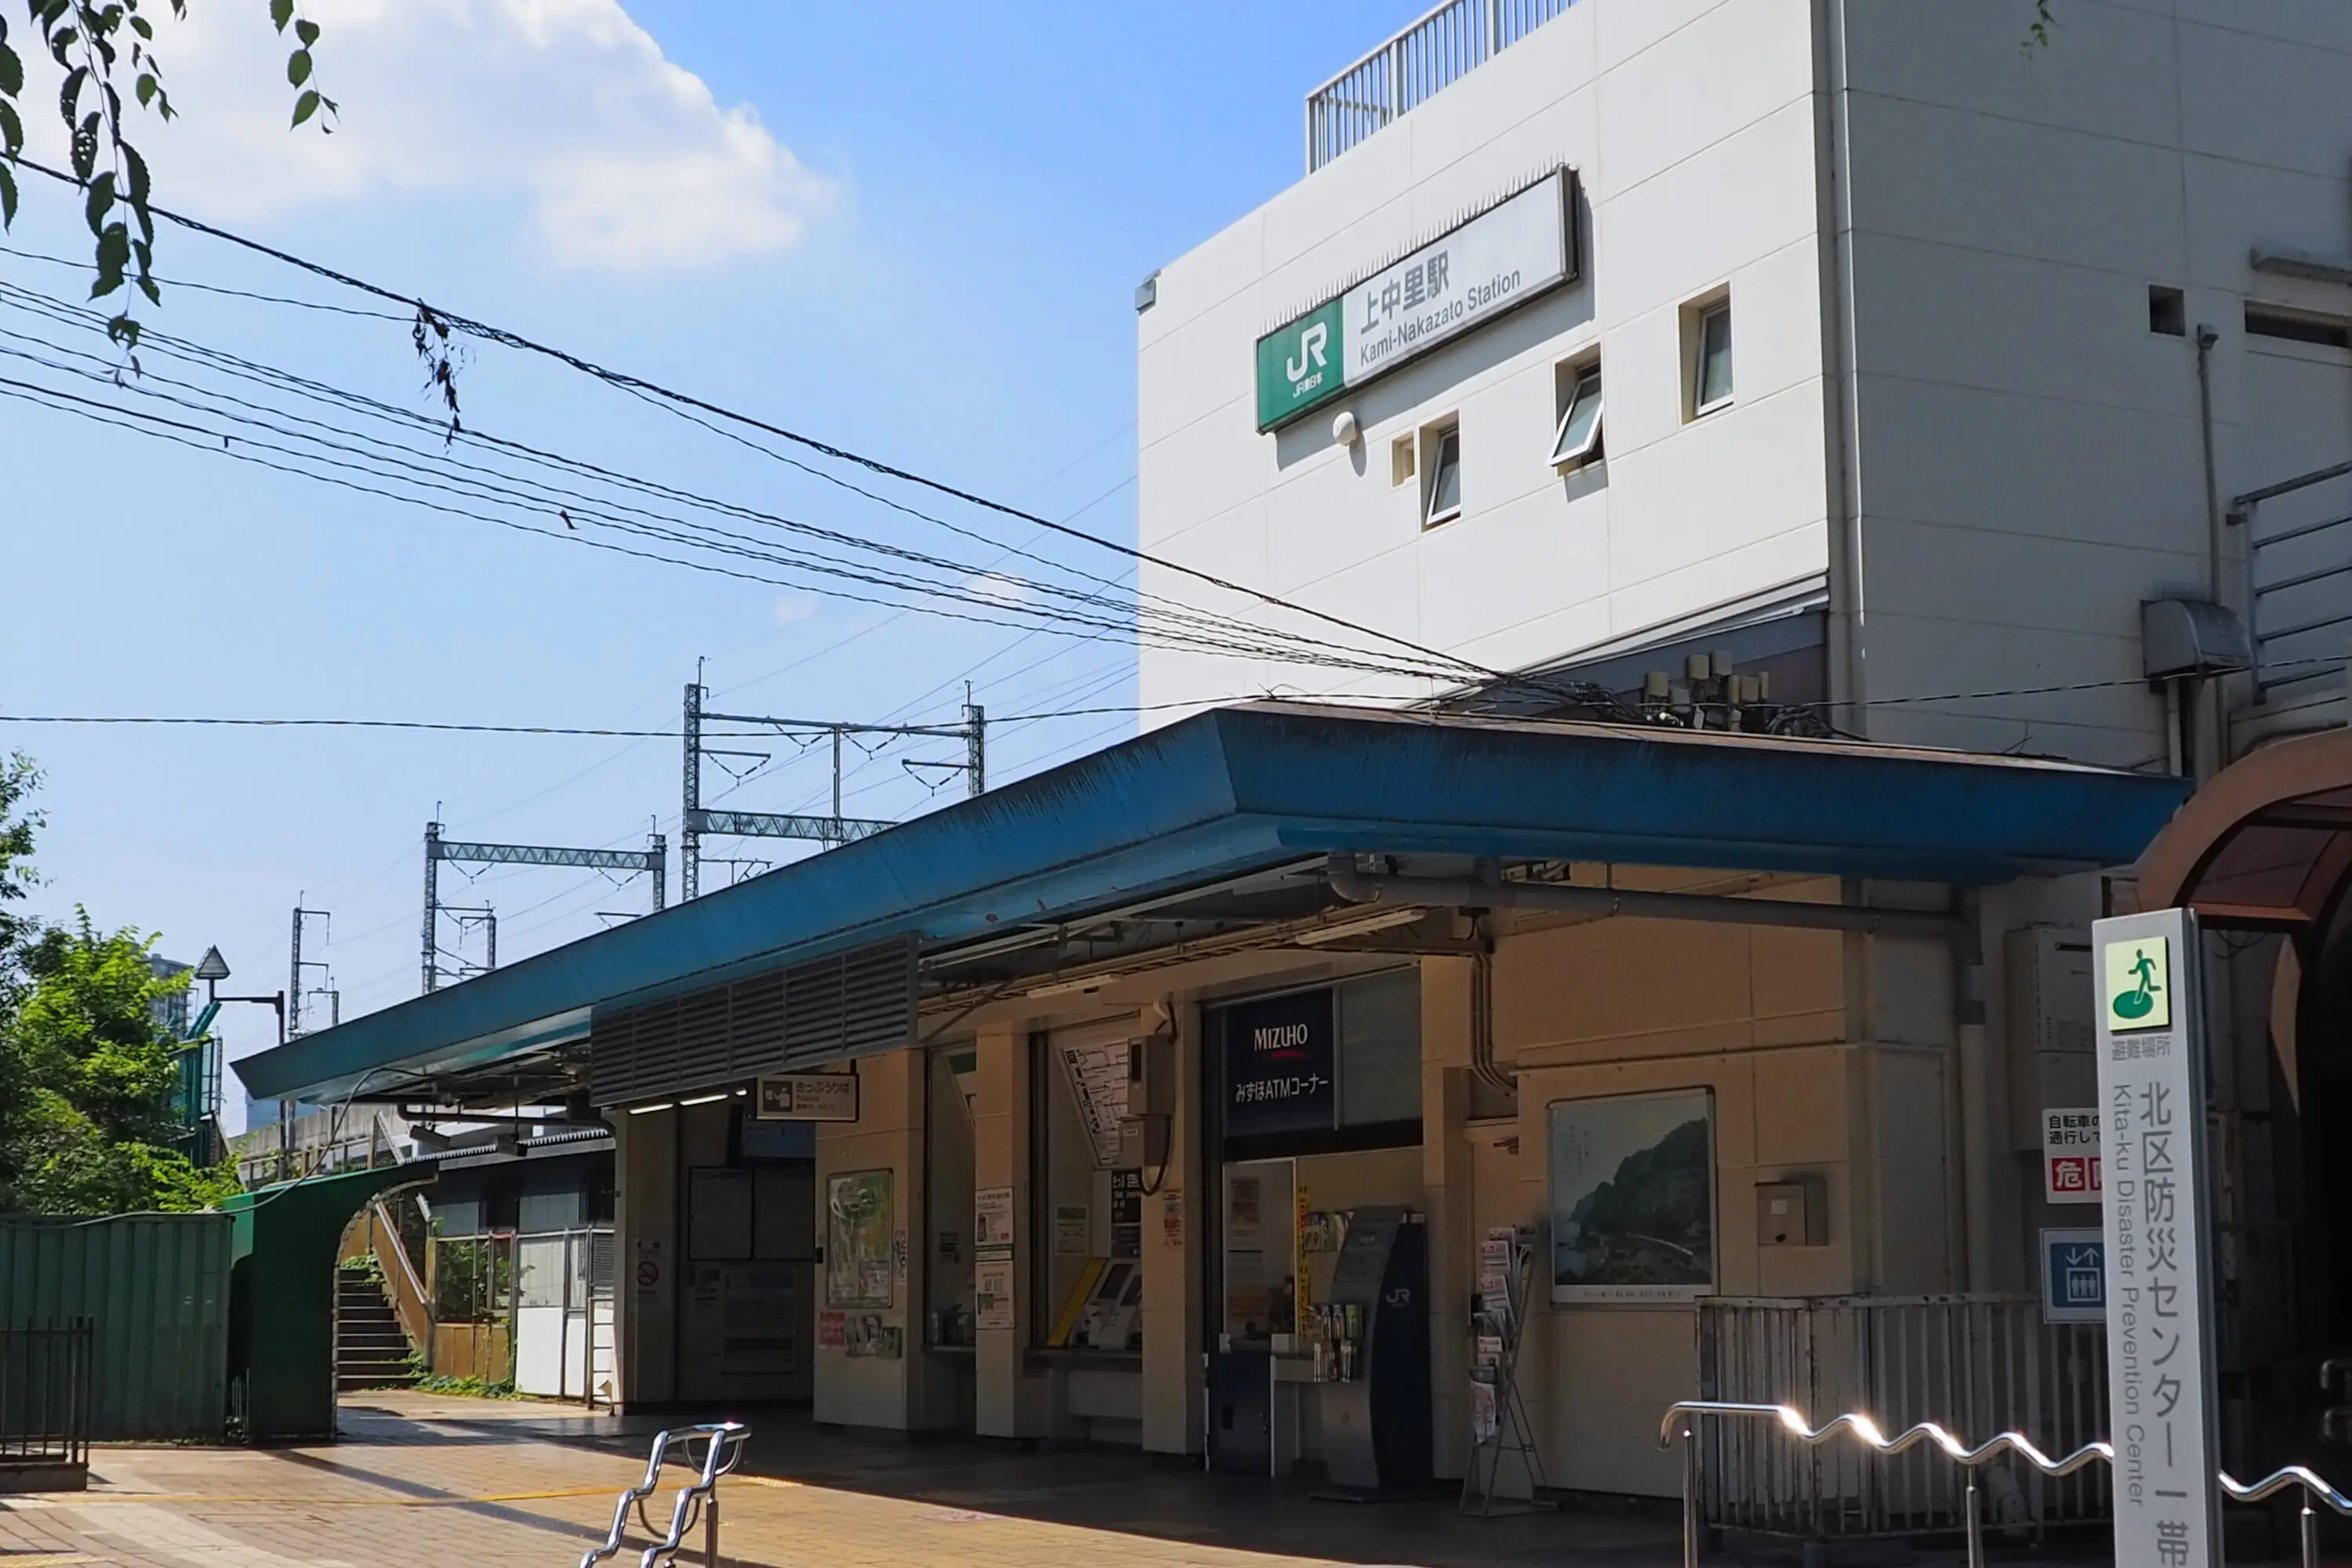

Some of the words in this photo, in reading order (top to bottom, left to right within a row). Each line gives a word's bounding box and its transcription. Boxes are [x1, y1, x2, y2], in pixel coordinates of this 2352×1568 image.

[1359, 249, 1450, 336] 上中里駅
[1359, 303, 1464, 367] Kami-Nakazato
[1468, 269, 1521, 311] Station
[1287, 321, 1327, 382] JR
[1254, 1023, 1308, 1051] MIZUHO
[2111, 1035, 2171, 1062] 避難場所
[1236, 1073, 1329, 1103] みずほATMコーナー
[2113, 1084, 2132, 1171] Kita-ku
[2117, 1180, 2136, 1279] Disaster
[2121, 1287, 2143, 1415] Prevention
[2125, 1424, 2145, 1507] Center
